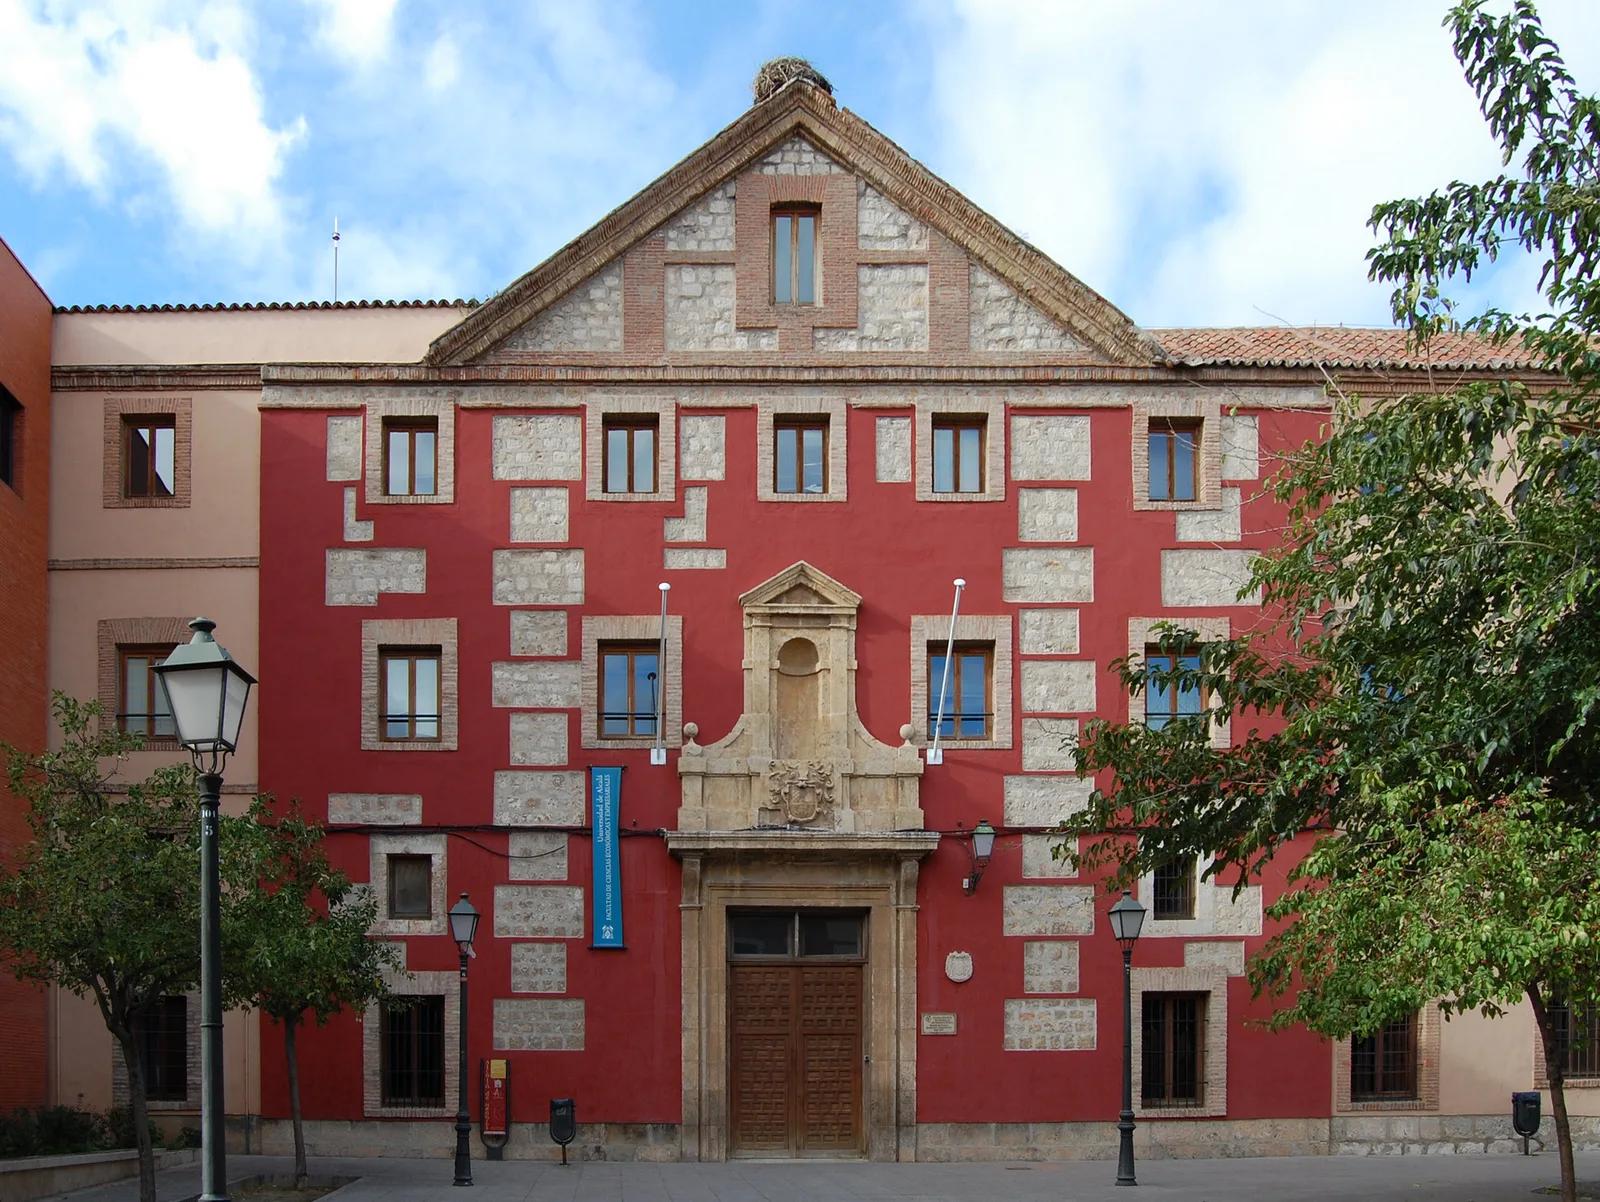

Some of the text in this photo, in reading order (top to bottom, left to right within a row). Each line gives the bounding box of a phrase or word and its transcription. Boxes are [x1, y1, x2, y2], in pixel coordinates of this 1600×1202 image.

[202, 809, 216, 818] 101
[596, 774, 604, 843] Universidad de Alcalá
[205, 825, 213, 836] 5
[605, 884, 612, 892] DE
